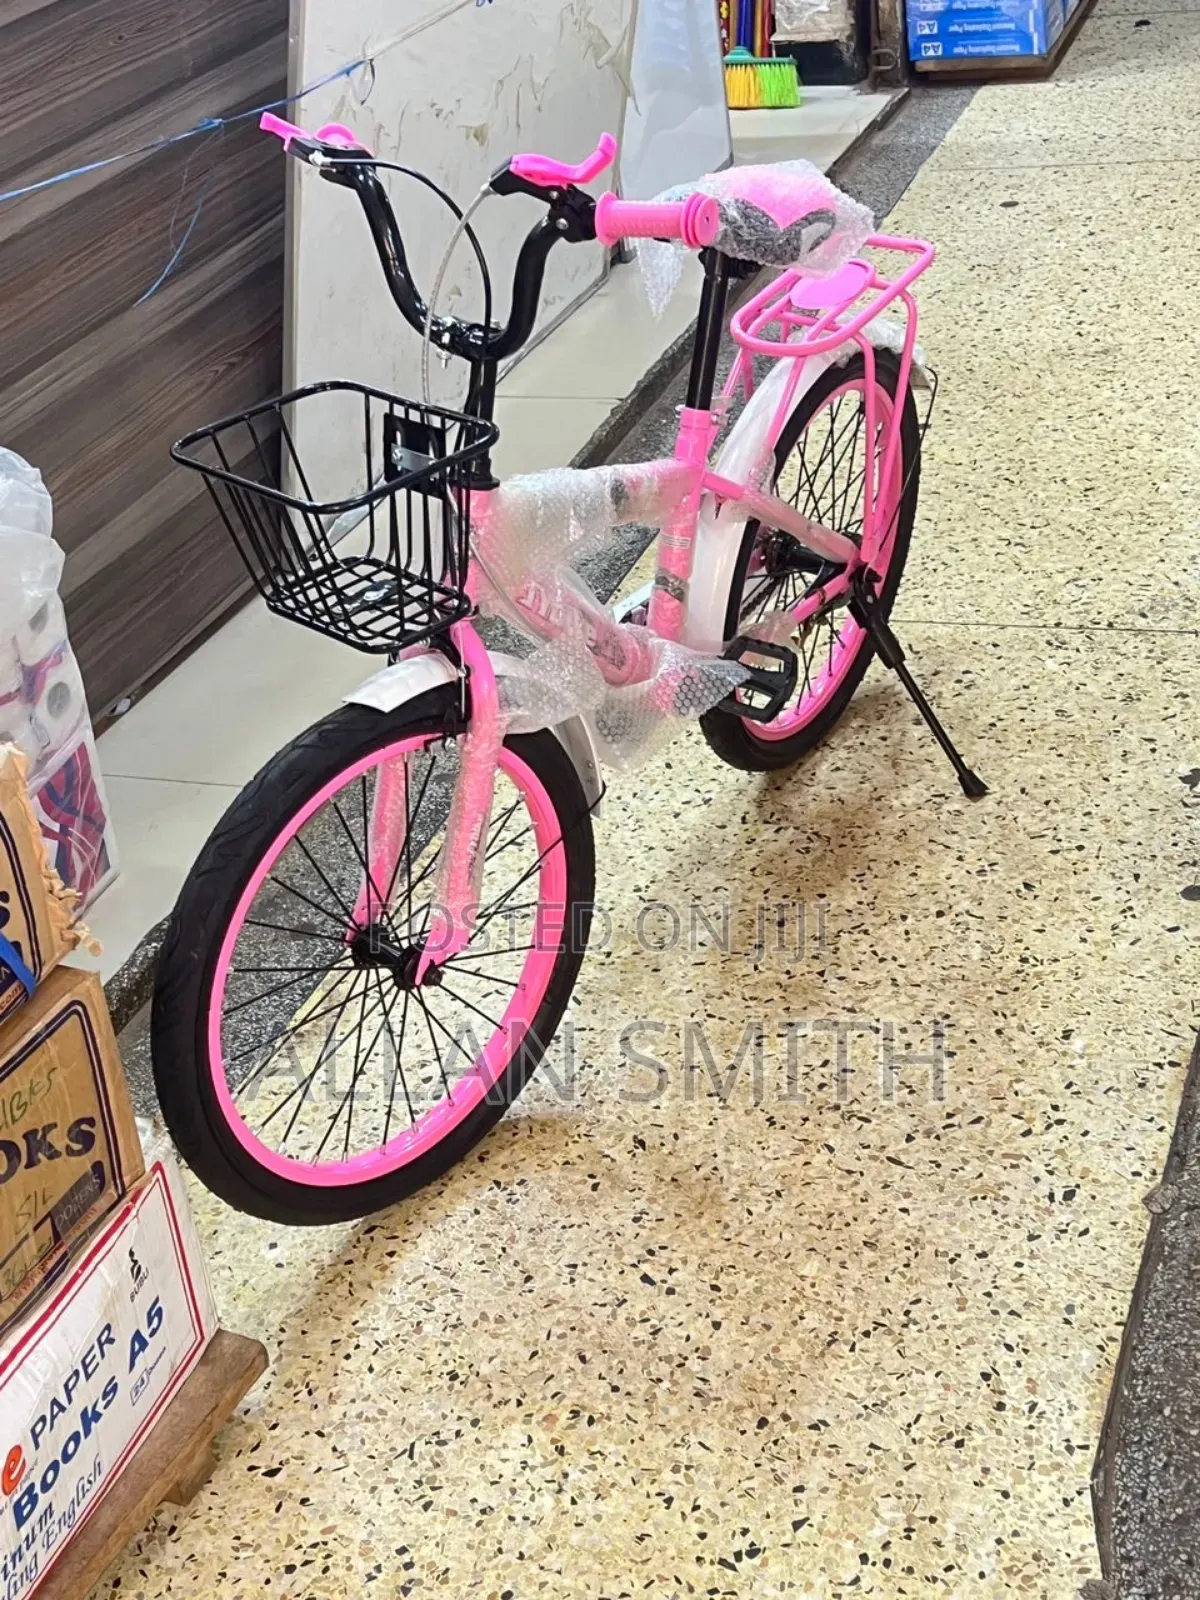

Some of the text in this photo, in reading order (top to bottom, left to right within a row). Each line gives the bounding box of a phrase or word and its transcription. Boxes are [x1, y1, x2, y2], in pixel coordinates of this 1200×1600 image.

[923, 44, 941, 54] A4
[30, 1323, 116, 1450] PAPER
[128, 1295, 163, 1375] A5
[2, 1551, 38, 1600] ling
[41, 1453, 102, 1552] English
